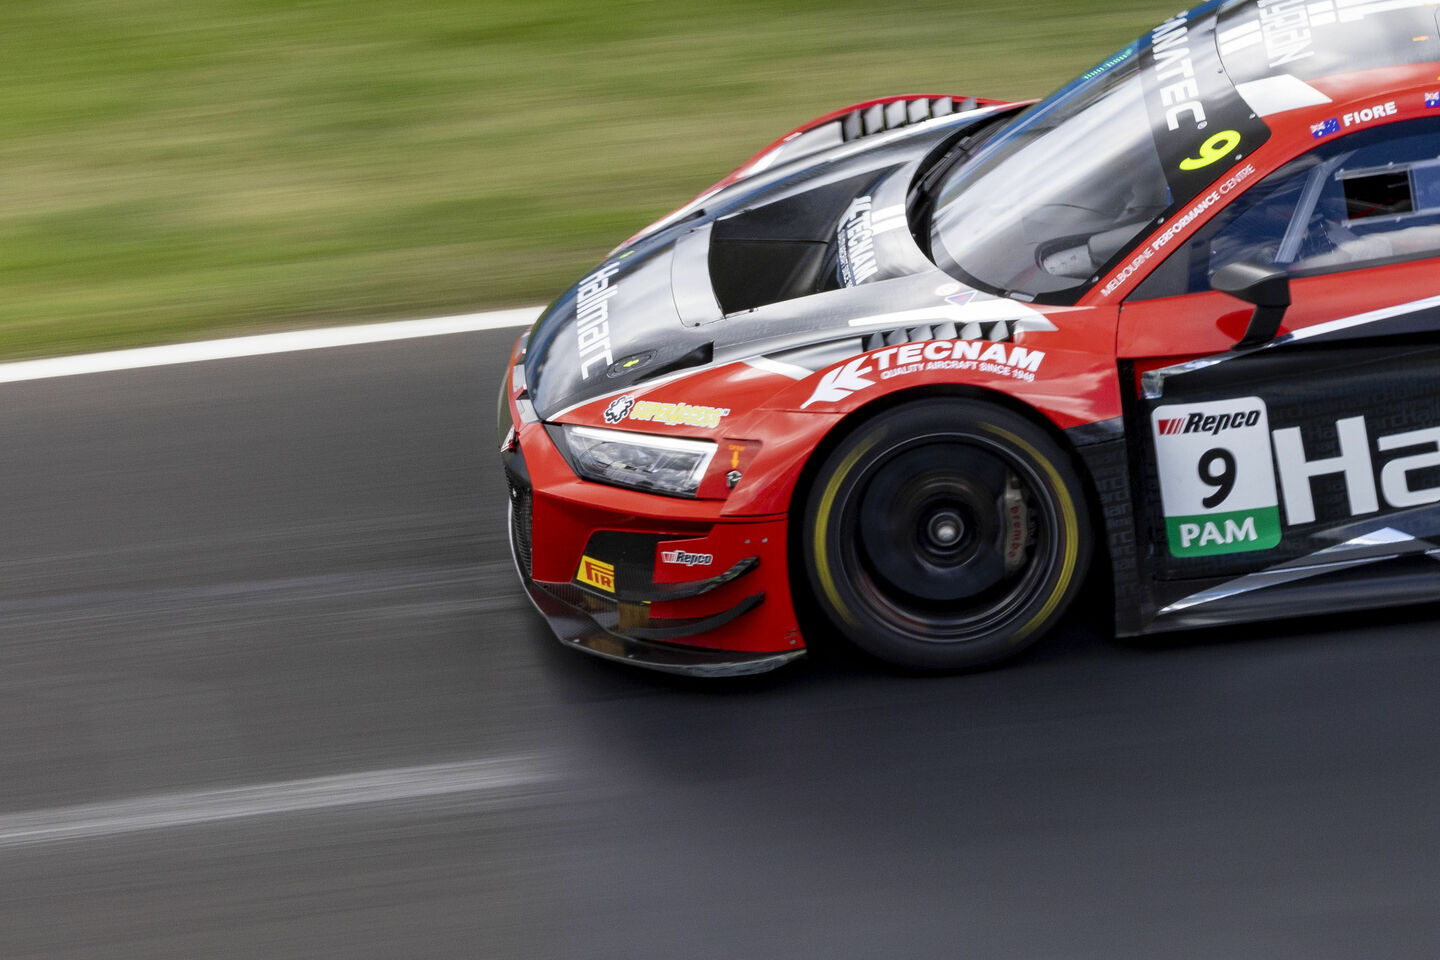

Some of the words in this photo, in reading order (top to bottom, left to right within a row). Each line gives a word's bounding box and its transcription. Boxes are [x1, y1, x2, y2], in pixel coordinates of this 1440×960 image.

[1343, 101, 1397, 127] FIORE
[1179, 130, 1241, 171] 9
[1101, 247, 1154, 296] MELBOURNE
[1152, 191, 1220, 251] PERFORMANCE
[1219, 163, 1255, 194] CENTRE
[847, 210, 878, 286] TECNAM
[577, 262, 619, 381] Hallmarc
[872, 341, 1046, 372] TECNAM
[880, 362, 925, 380] QUALITY
[926, 360, 978, 371] AIRCRAFT
[979, 363, 1011, 376] SINCE
[1012, 368, 1035, 383] 1948
[1183, 410, 1261, 435] Repco
[1198, 447, 1237, 509] 9
[1178, 517, 1258, 548] PAM
[676, 551, 712, 566] Repco
